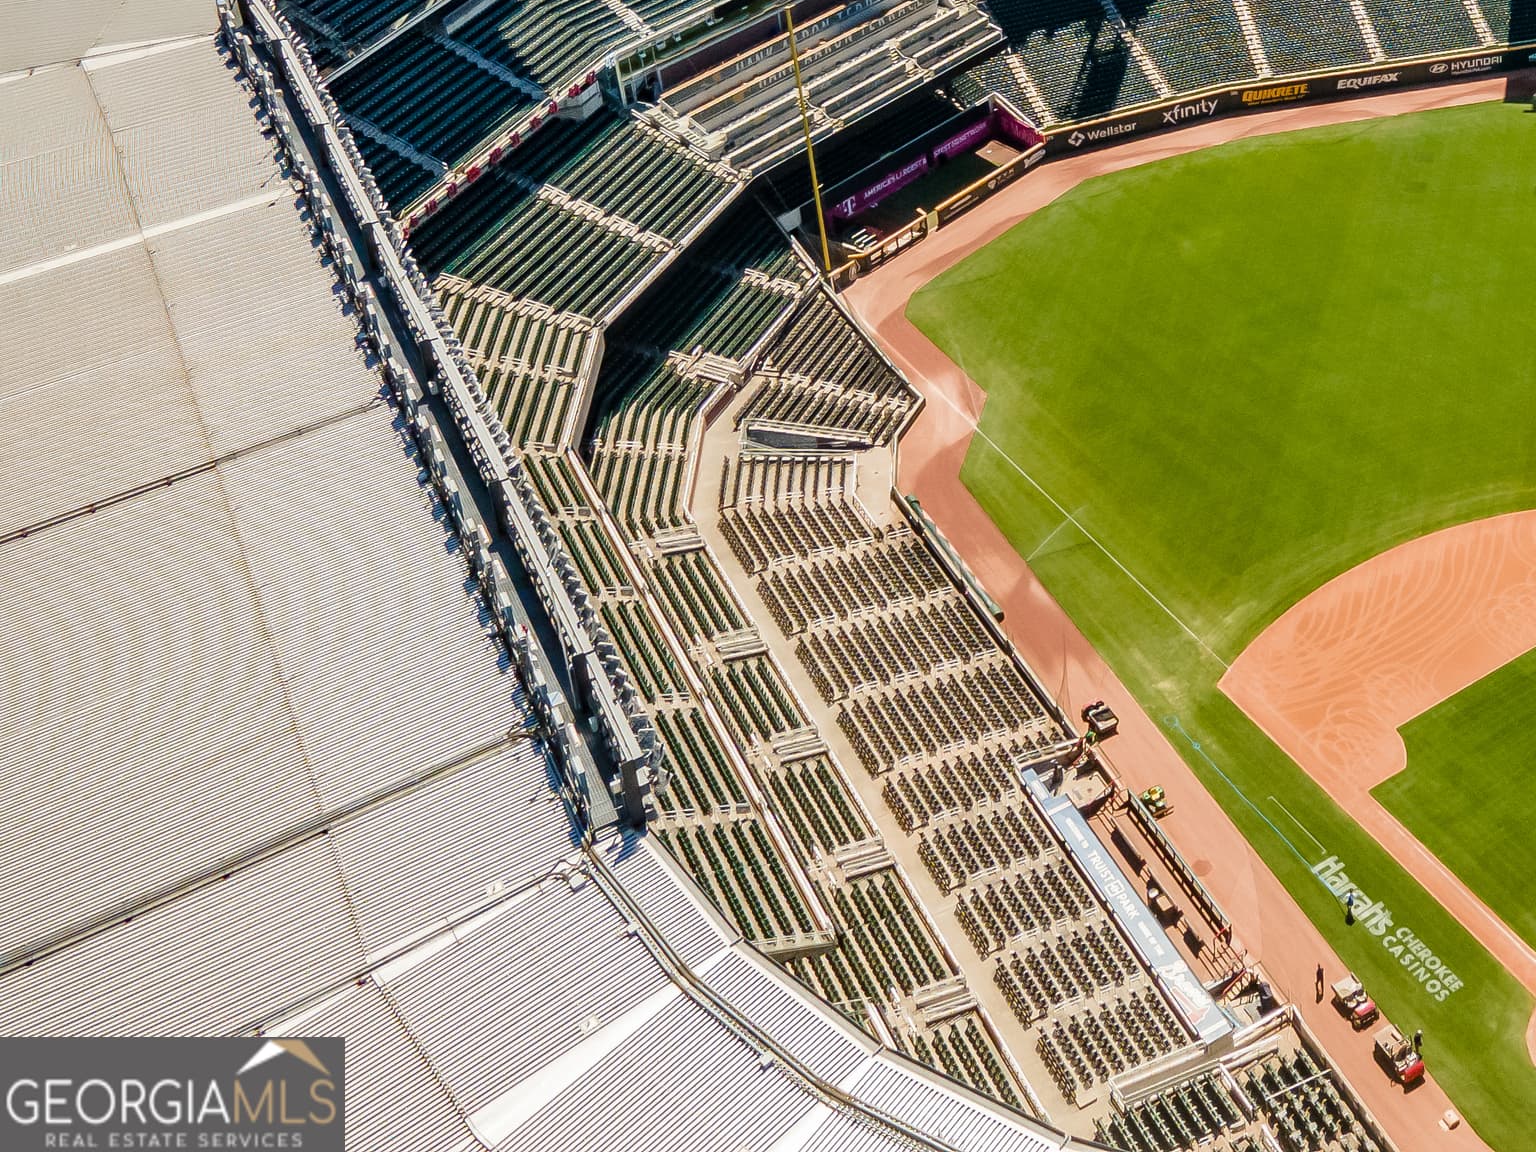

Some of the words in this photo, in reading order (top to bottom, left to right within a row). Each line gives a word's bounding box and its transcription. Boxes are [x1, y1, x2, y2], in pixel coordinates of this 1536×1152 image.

[1451, 55, 1503, 71] HYUNDAI
[1337, 73, 1399, 90] EQUIFAX
[1242, 84, 1309, 102] QUIKRETE
[1162, 99, 1219, 125] xfinity
[1087, 122, 1137, 141] Wellstar
[1087, 851, 1115, 885] TRUIST
[1118, 890, 1140, 920] PARK
[1382, 936, 1450, 1002] CASINOS
[1396, 927, 1464, 993] CHEROKEE
